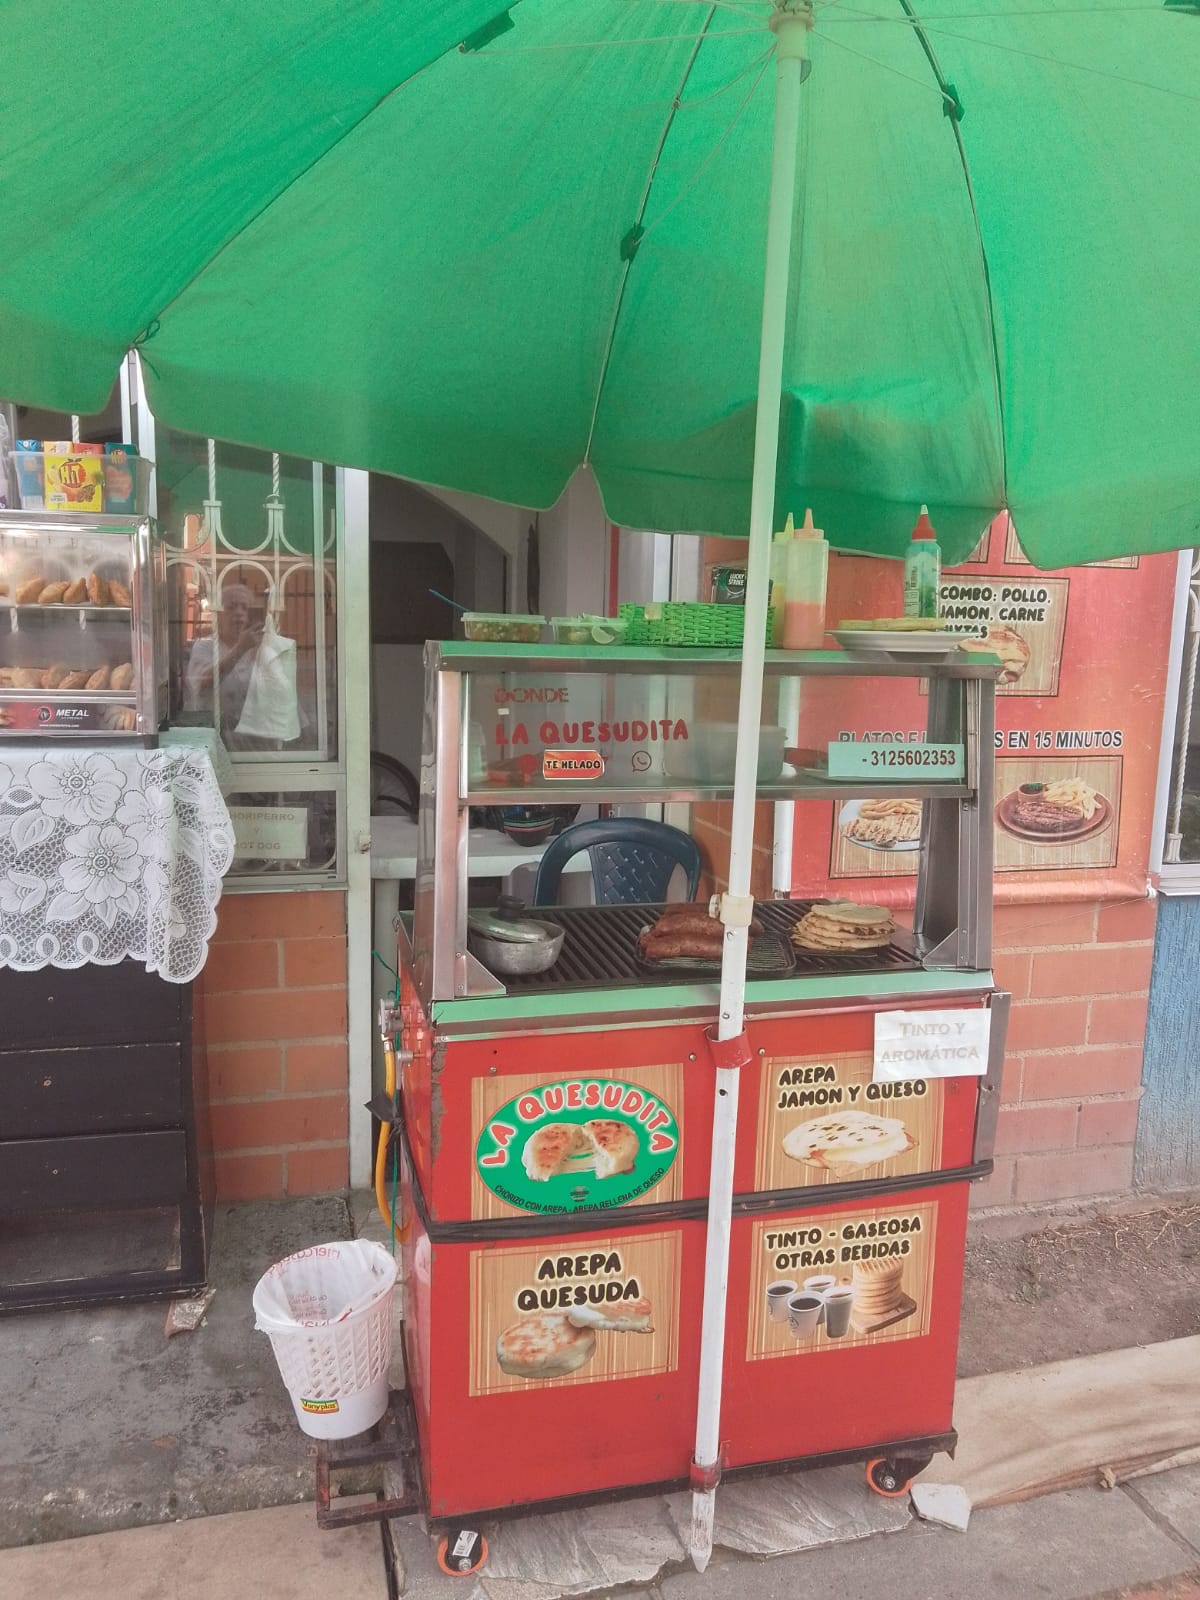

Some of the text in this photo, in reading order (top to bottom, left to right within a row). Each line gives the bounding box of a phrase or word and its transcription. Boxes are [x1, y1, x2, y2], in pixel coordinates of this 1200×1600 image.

[940, 586, 997, 602] COMBO:
[999, 607, 1046, 622] CARNE
[494, 687, 569, 704] DONDE
[56, 708, 89, 717] METAL
[495, 719, 689, 745] LA QUESUDITA
[1008, 731, 1030, 748] EN
[1034, 731, 1052, 748] 15
[1056, 731, 1122, 748] MINUTOS
[546, 760, 601, 769] TE HELADO
[871, 749, 956, 766] 3125602353
[257, 842, 281, 850] DOG
[954, 1022, 967, 1035] Y
[779, 1066, 836, 1086] AREPA
[778, 1079, 927, 1109] JAMON Y QUESO
[482, 1083, 674, 1165] LA QUESUDITA
[493, 1184, 525, 1206] CHORIZO
[525, 1200, 542, 1211] CON
[543, 1205, 567, 1215] AREPA
[573, 1204, 599, 1215] AREPA
[599, 1192, 633, 1209] RELLENA
[633, 1184, 643, 1195] DE
[643, 1167, 665, 1189] QUESO
[766, 1228, 822, 1249] TINTO
[842, 1216, 921, 1240] GASEOSA
[775, 1239, 911, 1270] OTRAS BEBIDAS
[538, 1252, 622, 1280] AREPA
[517, 1278, 640, 1311] QUESUDA
